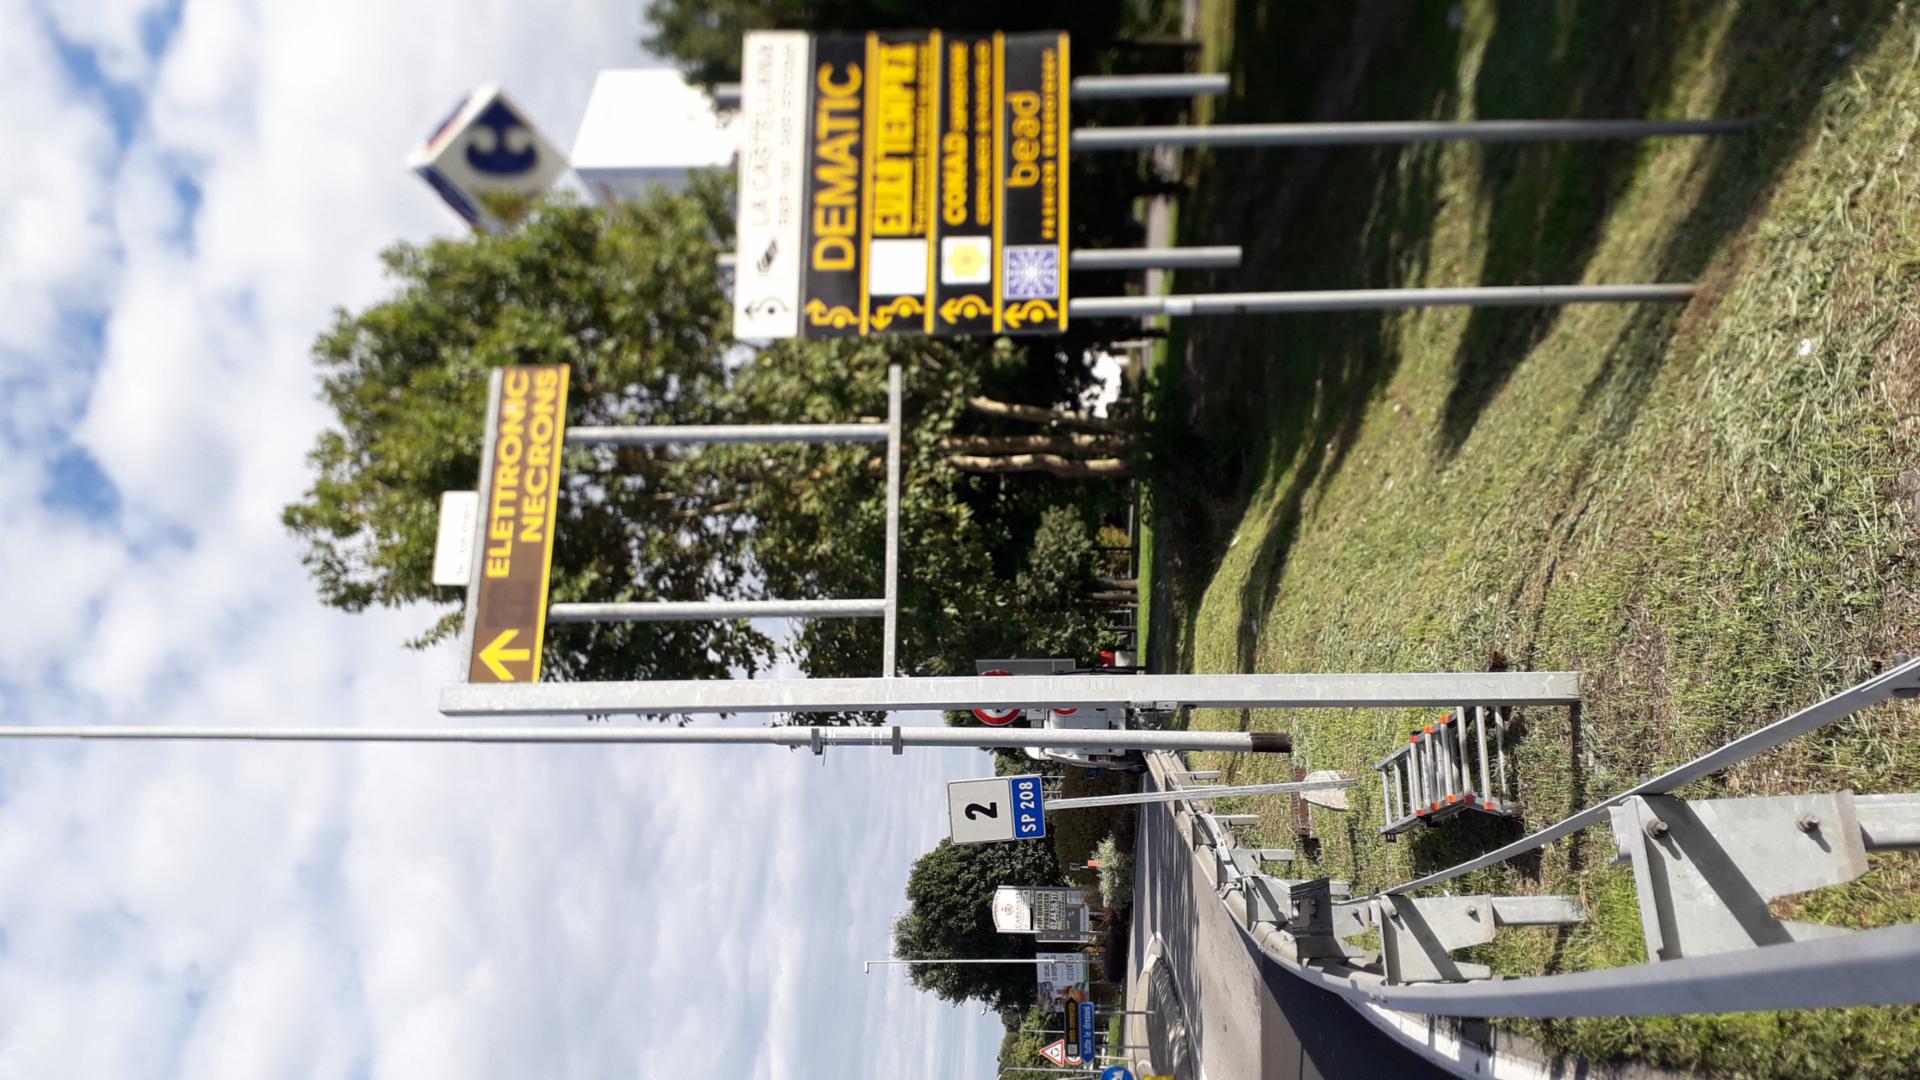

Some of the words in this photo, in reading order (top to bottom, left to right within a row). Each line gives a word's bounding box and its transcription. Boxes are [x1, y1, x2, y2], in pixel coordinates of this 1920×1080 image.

[812, 62, 862, 272] DEMATIC
[1007, 92, 1040, 188] bead
[942, 132, 968, 225] CONAD
[520, 370, 559, 542] NECRONS
[964, 802, 998, 820] 2
[1018, 782, 1035, 808] 208
[1021, 814, 1036, 832] SP
[1082, 1006, 1090, 1030] direzioni
